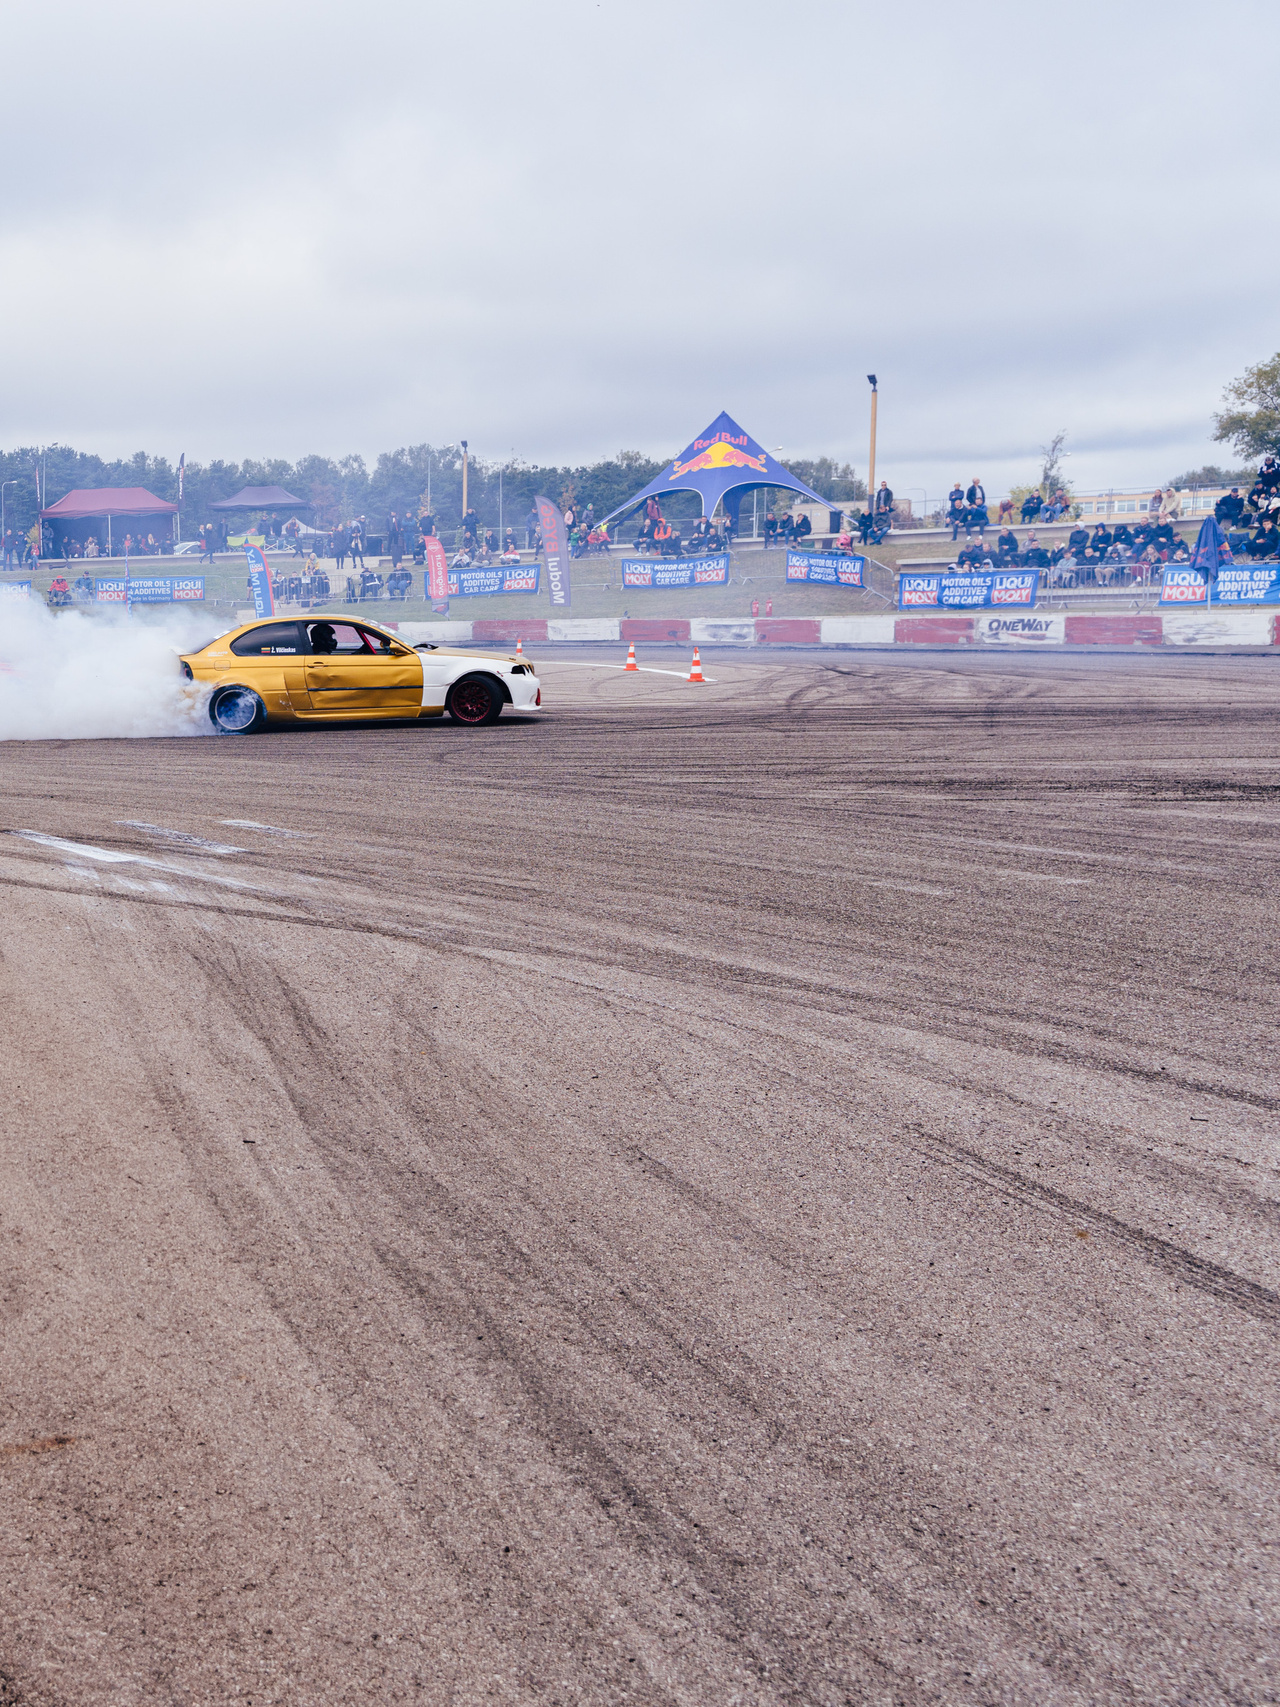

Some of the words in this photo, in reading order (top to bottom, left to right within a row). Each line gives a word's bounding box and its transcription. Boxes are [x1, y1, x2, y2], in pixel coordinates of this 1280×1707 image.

[693, 432, 720, 451] Red
[721, 432, 748, 446] Bull
[625, 563, 652, 574] LIQUI
[678, 562, 694, 570] OILS
[696, 559, 725, 571] LIQUI
[825, 559, 837, 568] OILS
[838, 561, 861, 573] LIQUI
[460, 572, 486, 580] MOTOR
[486, 571, 503, 579] OILS
[506, 569, 536, 580] LIQUI
[655, 570, 691, 578] ADDITIVES
[696, 569, 726, 582] MOLY
[788, 566, 808, 578] MOLY
[1218, 571, 1251, 581] MOTOR
[1252, 570, 1277, 581] OILS
[154, 580, 171, 588] OILS
[463, 578, 501, 587] ADDITIVES
[504, 578, 535, 590] MOLY
[625, 574, 652, 585] MOLY
[670, 577, 690, 585] CARE
[838, 572, 861, 585] MOLY
[941, 578, 971, 587] MOTOR
[971, 577, 992, 586] OILS
[995, 577, 1033, 590] LIQUI
[98, 582, 125, 592] LIQUI
[174, 581, 202, 590] LIQUI
[464, 586, 479, 594] CAR
[905, 579, 937, 591] LIQUI
[1217, 580, 1271, 592] ADDITIVES
[98, 592, 125, 600] MOLY
[134, 587, 171, 595] ADDITIVES
[174, 590, 202, 599] MOLY
[942, 586, 988, 596] ADDITIVES
[993, 589, 1030, 602] MOLY
[1163, 586, 1205, 600] MOLY
[1219, 591, 1239, 600] CAR
[1240, 589, 1267, 599] CARE
[904, 592, 937, 603] MOLY
[942, 596, 961, 605] CAR
[960, 595, 985, 604] CARE
